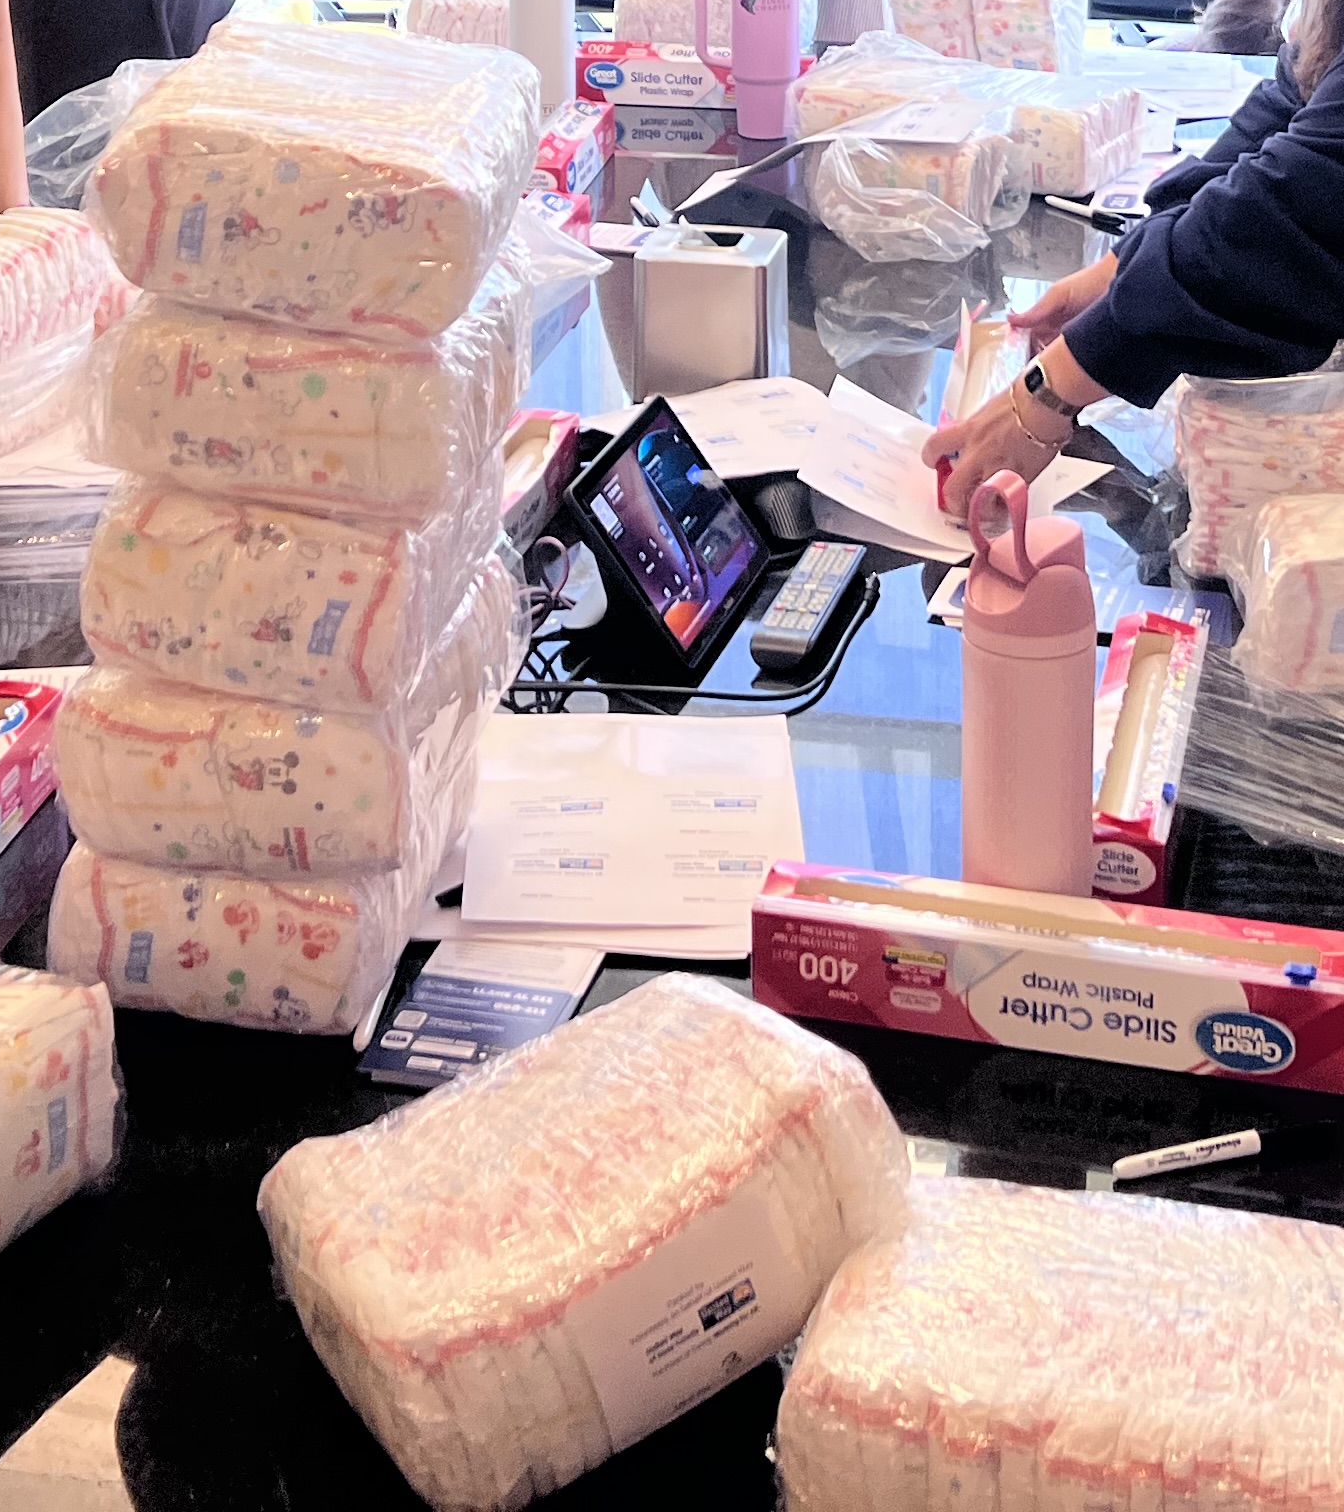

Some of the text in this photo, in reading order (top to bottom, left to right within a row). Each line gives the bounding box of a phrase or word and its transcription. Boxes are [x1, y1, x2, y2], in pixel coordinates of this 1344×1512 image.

[630, 71, 703, 86] Slide Cutter
[639, 86, 694, 97] Plastic Wrap
[1102, 848, 1135, 863] Slide
[1097, 859, 1140, 876] Cutter
[798, 951, 859, 985] 400
[1022, 971, 1154, 1010] Plastic Wrap
[998, 995, 1178, 1045] Slide Cutter
[1212, 1020, 1265, 1042] Value
[1212, 1033, 1283, 1064] Great
